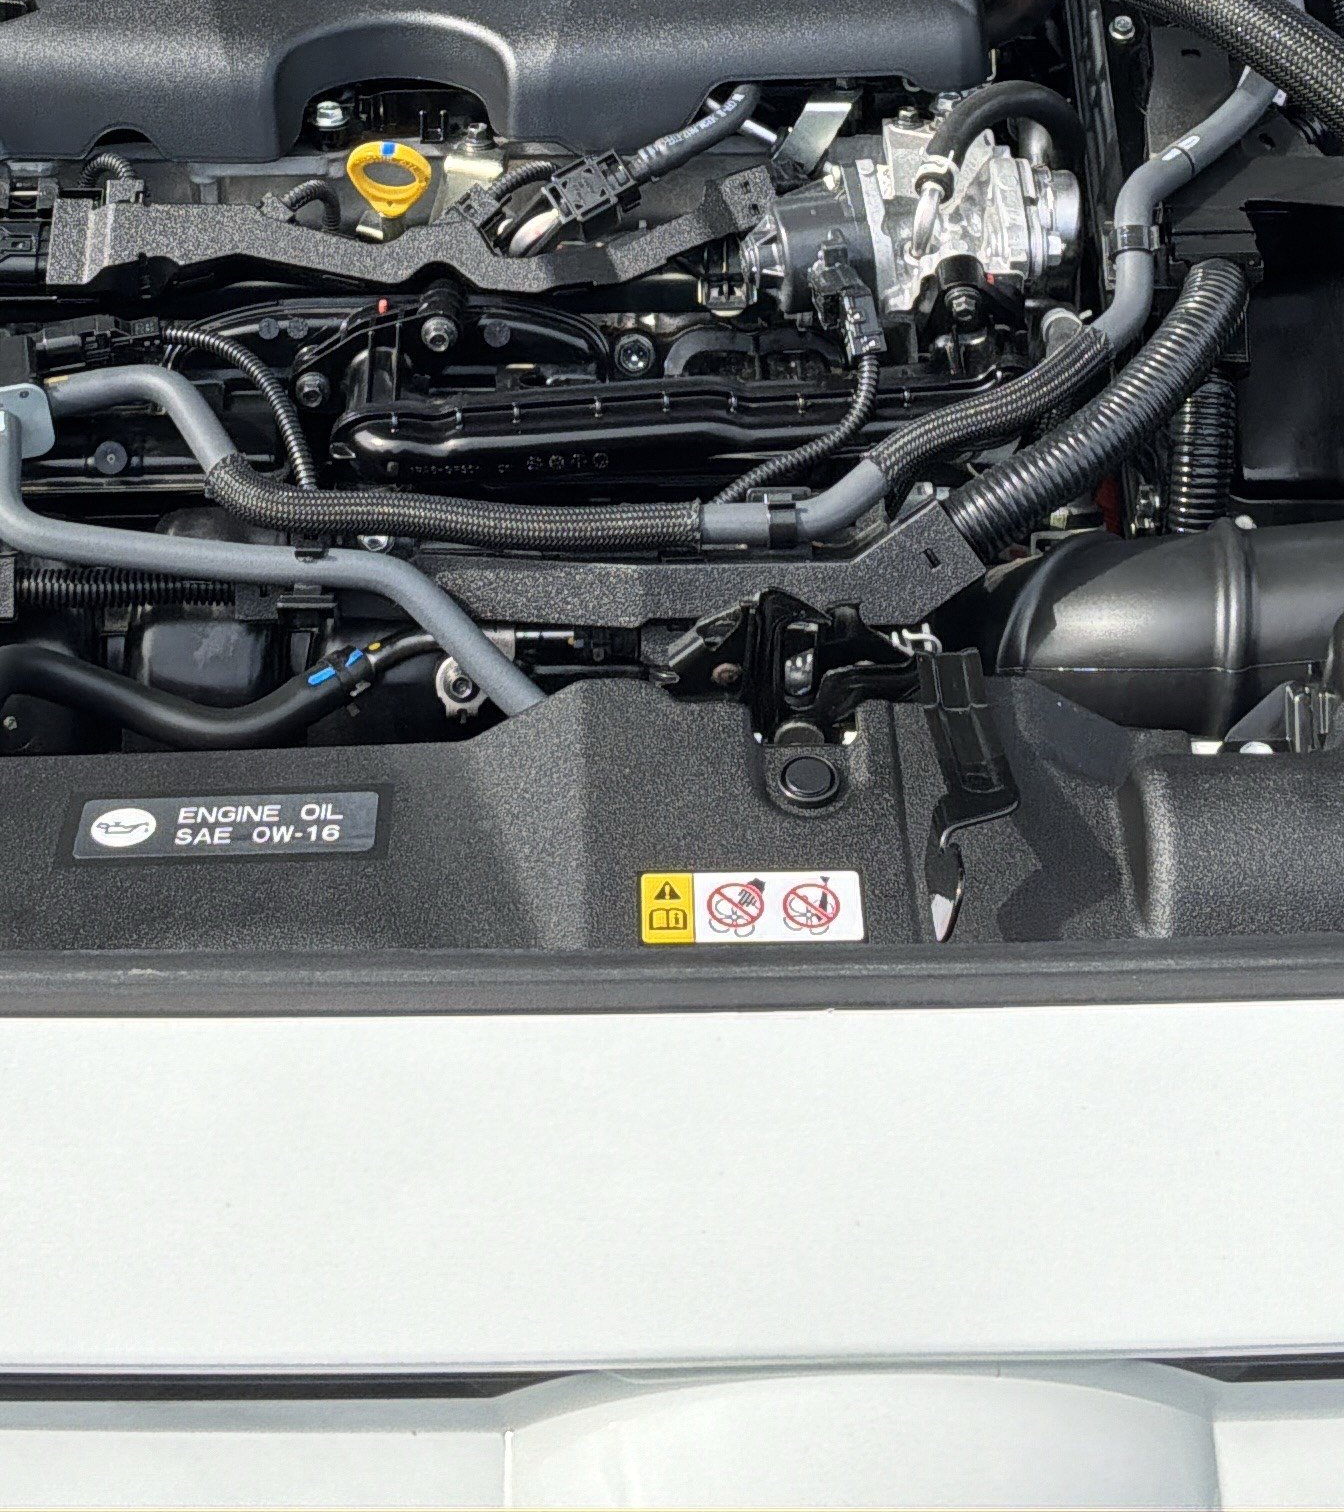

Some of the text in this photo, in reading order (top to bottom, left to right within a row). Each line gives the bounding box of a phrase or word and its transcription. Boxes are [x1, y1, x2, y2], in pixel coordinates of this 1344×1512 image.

[177, 803, 344, 824] ENGINE OIL
[174, 826, 234, 846] SAE
